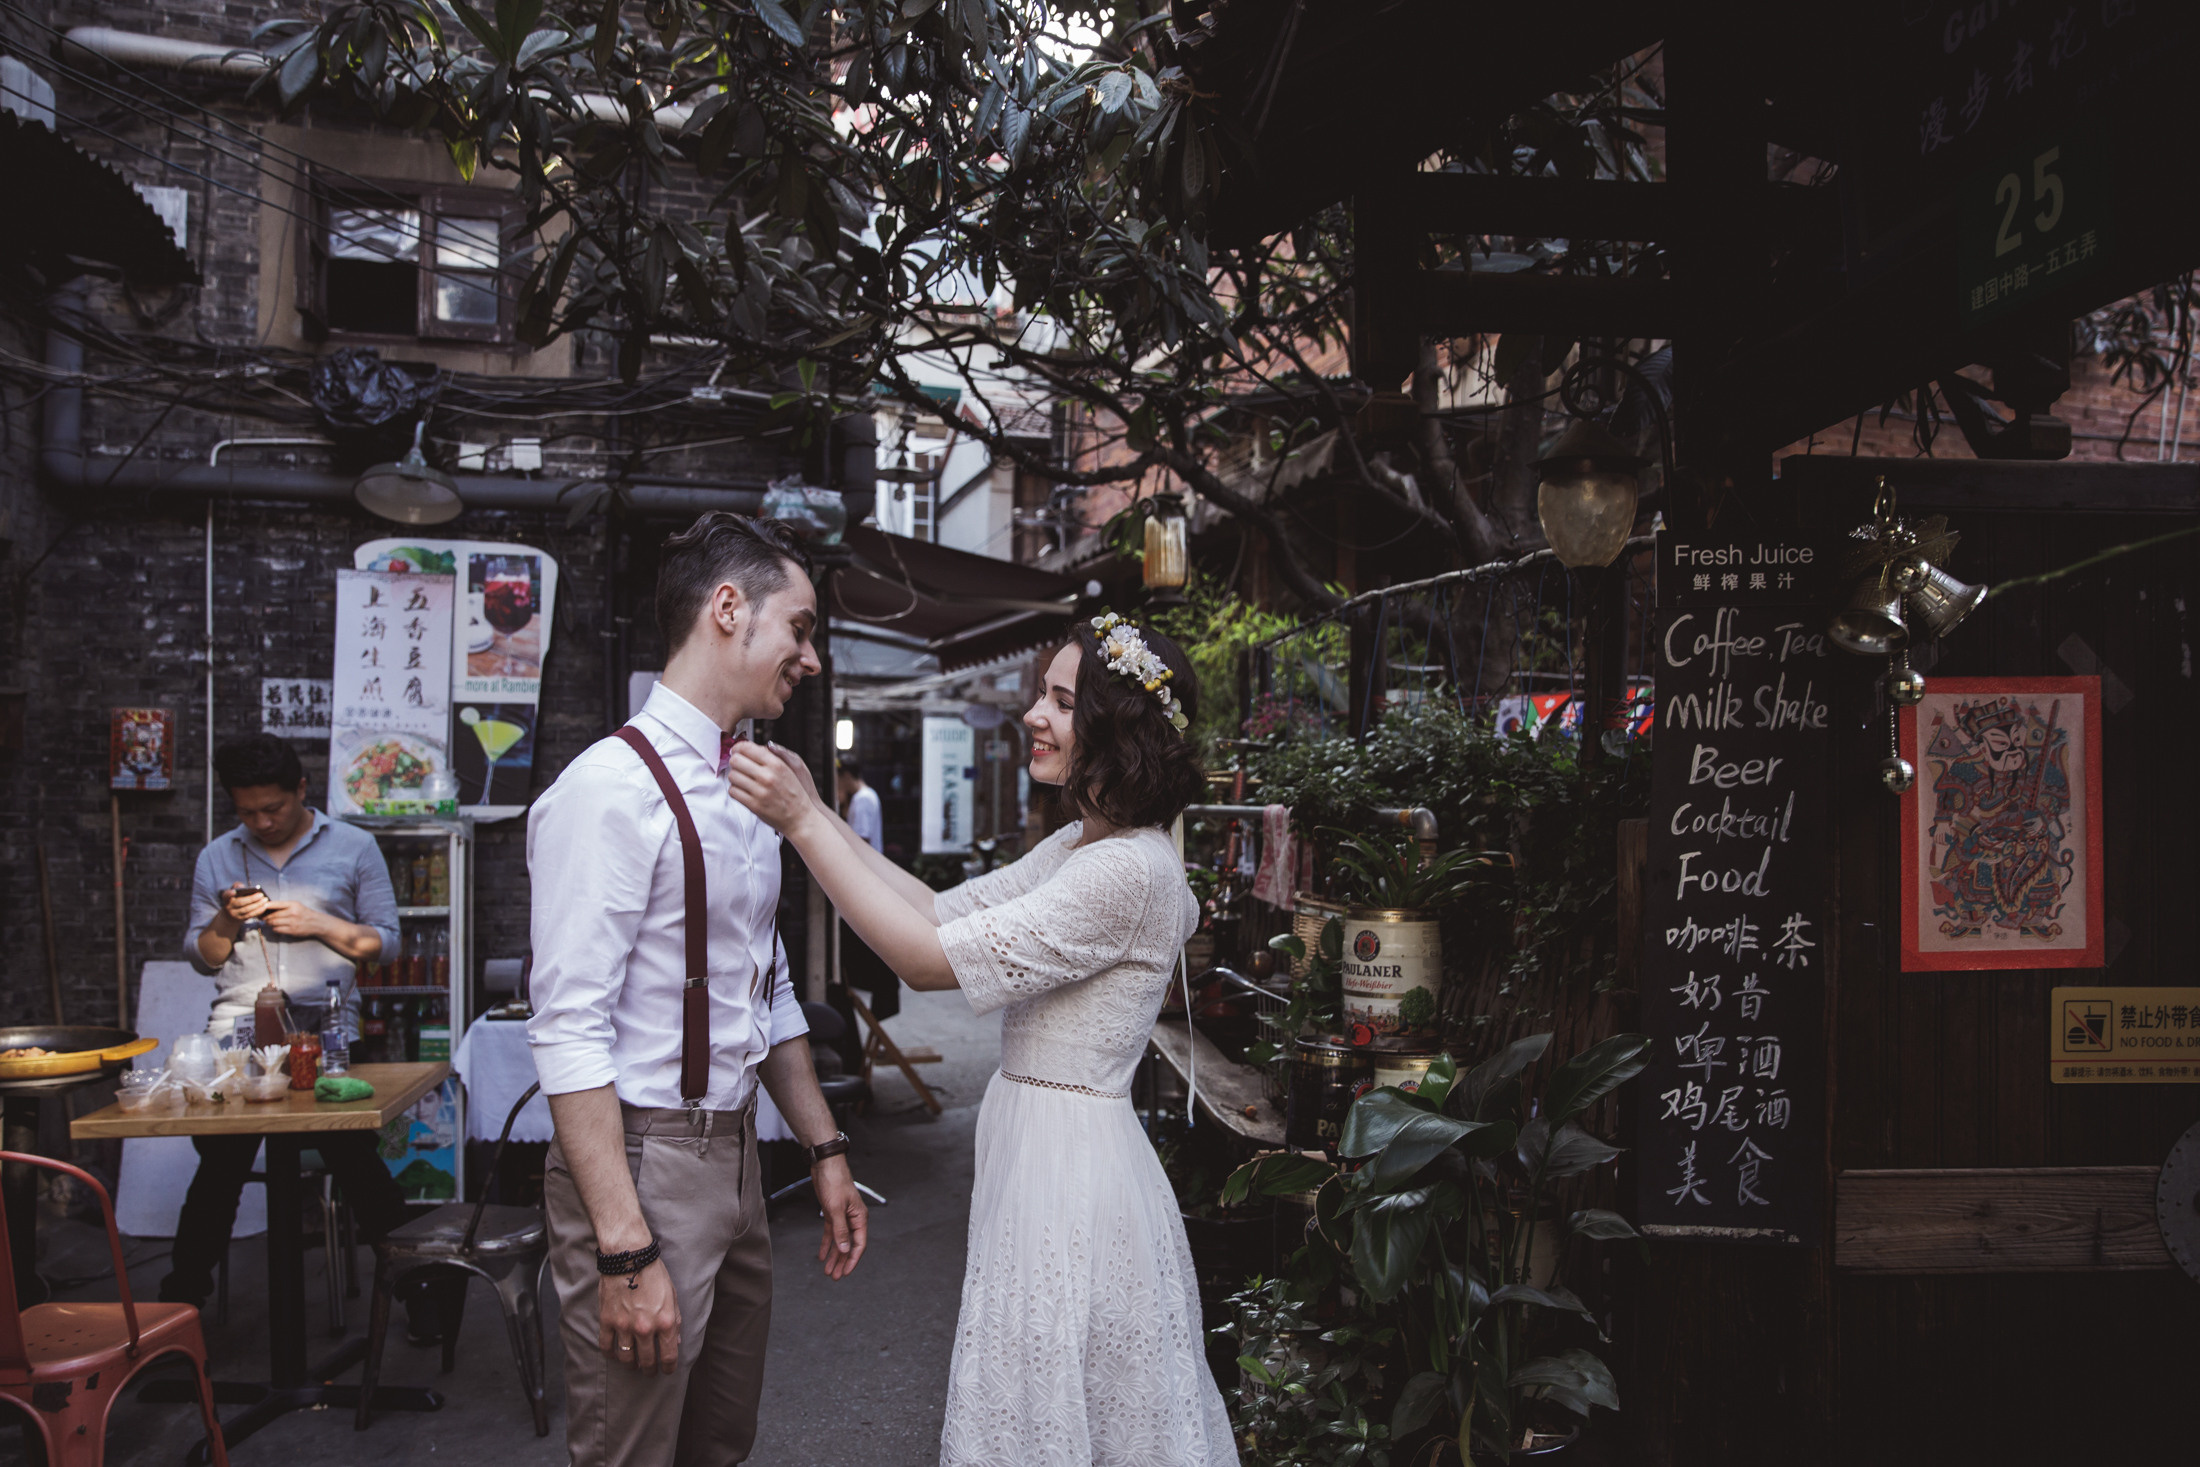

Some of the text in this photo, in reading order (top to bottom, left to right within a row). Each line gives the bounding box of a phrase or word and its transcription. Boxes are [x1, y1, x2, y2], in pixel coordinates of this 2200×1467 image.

[1943, 0, 2019, 55] Gar
[1994, 145, 2064, 258] 25
[1970, 229, 2098, 311] 建国中路一五五弄
[1675, 543, 1814, 566] Fresh Juice
[1692, 572, 1795, 591] 鲜榨果汁
[402, 585, 431, 708] 五香豆腐
[1774, 622, 1827, 663] Tea
[1666, 672, 1828, 731] Milk Shake
[1689, 746, 1784, 789] Beer
[1670, 792, 1794, 843] Cocktail
[1677, 846, 1771, 900] Food
[1342, 962, 1402, 978] PAULANER
[1670, 971, 1771, 1022] 奶昔
[1675, 1021, 1782, 1083] 啤酒
[2120, 1036, 2138, 1047] NO
[2141, 1036, 2172, 1047] FOOD
[2175, 1036, 2184, 1048] &
[1350, 1077, 1371, 1093] PAULA
[1660, 1080, 1791, 1132] 鸡尾酒
[1666, 1136, 1774, 1206] 美食
